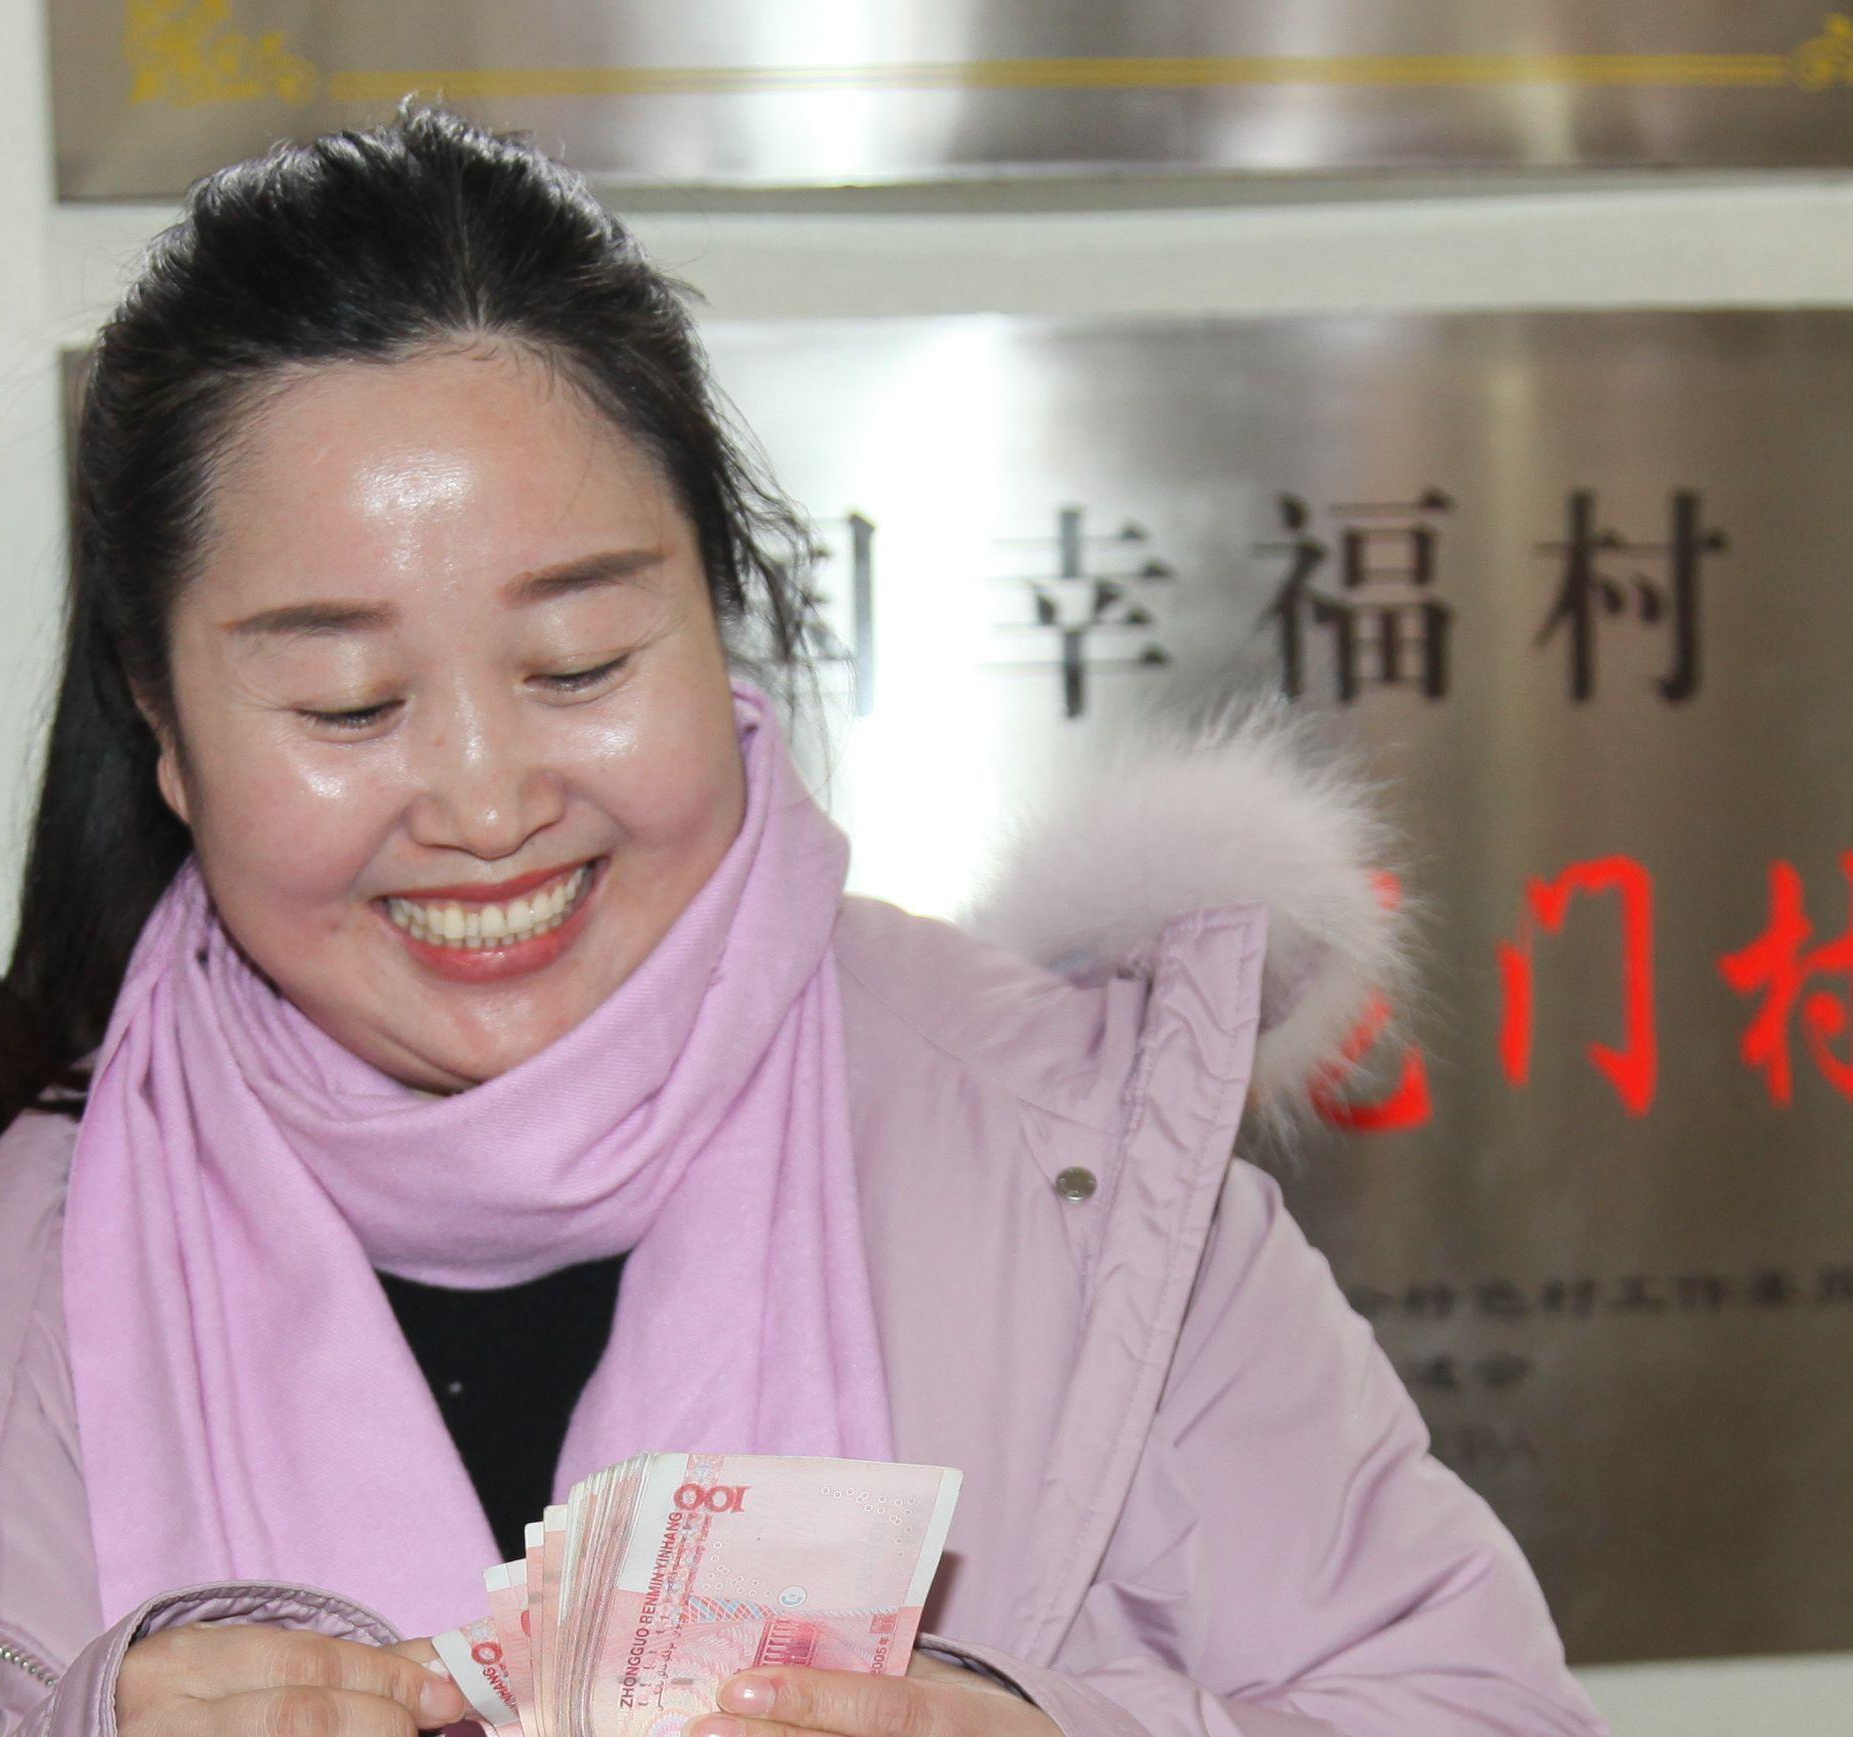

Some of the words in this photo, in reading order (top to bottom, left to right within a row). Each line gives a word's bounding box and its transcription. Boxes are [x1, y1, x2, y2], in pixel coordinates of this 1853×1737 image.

[673, 1482, 751, 1514] 100
[620, 1627, 649, 1709] ZHONGGUO
[653, 1511, 683, 1576] YINHANG
